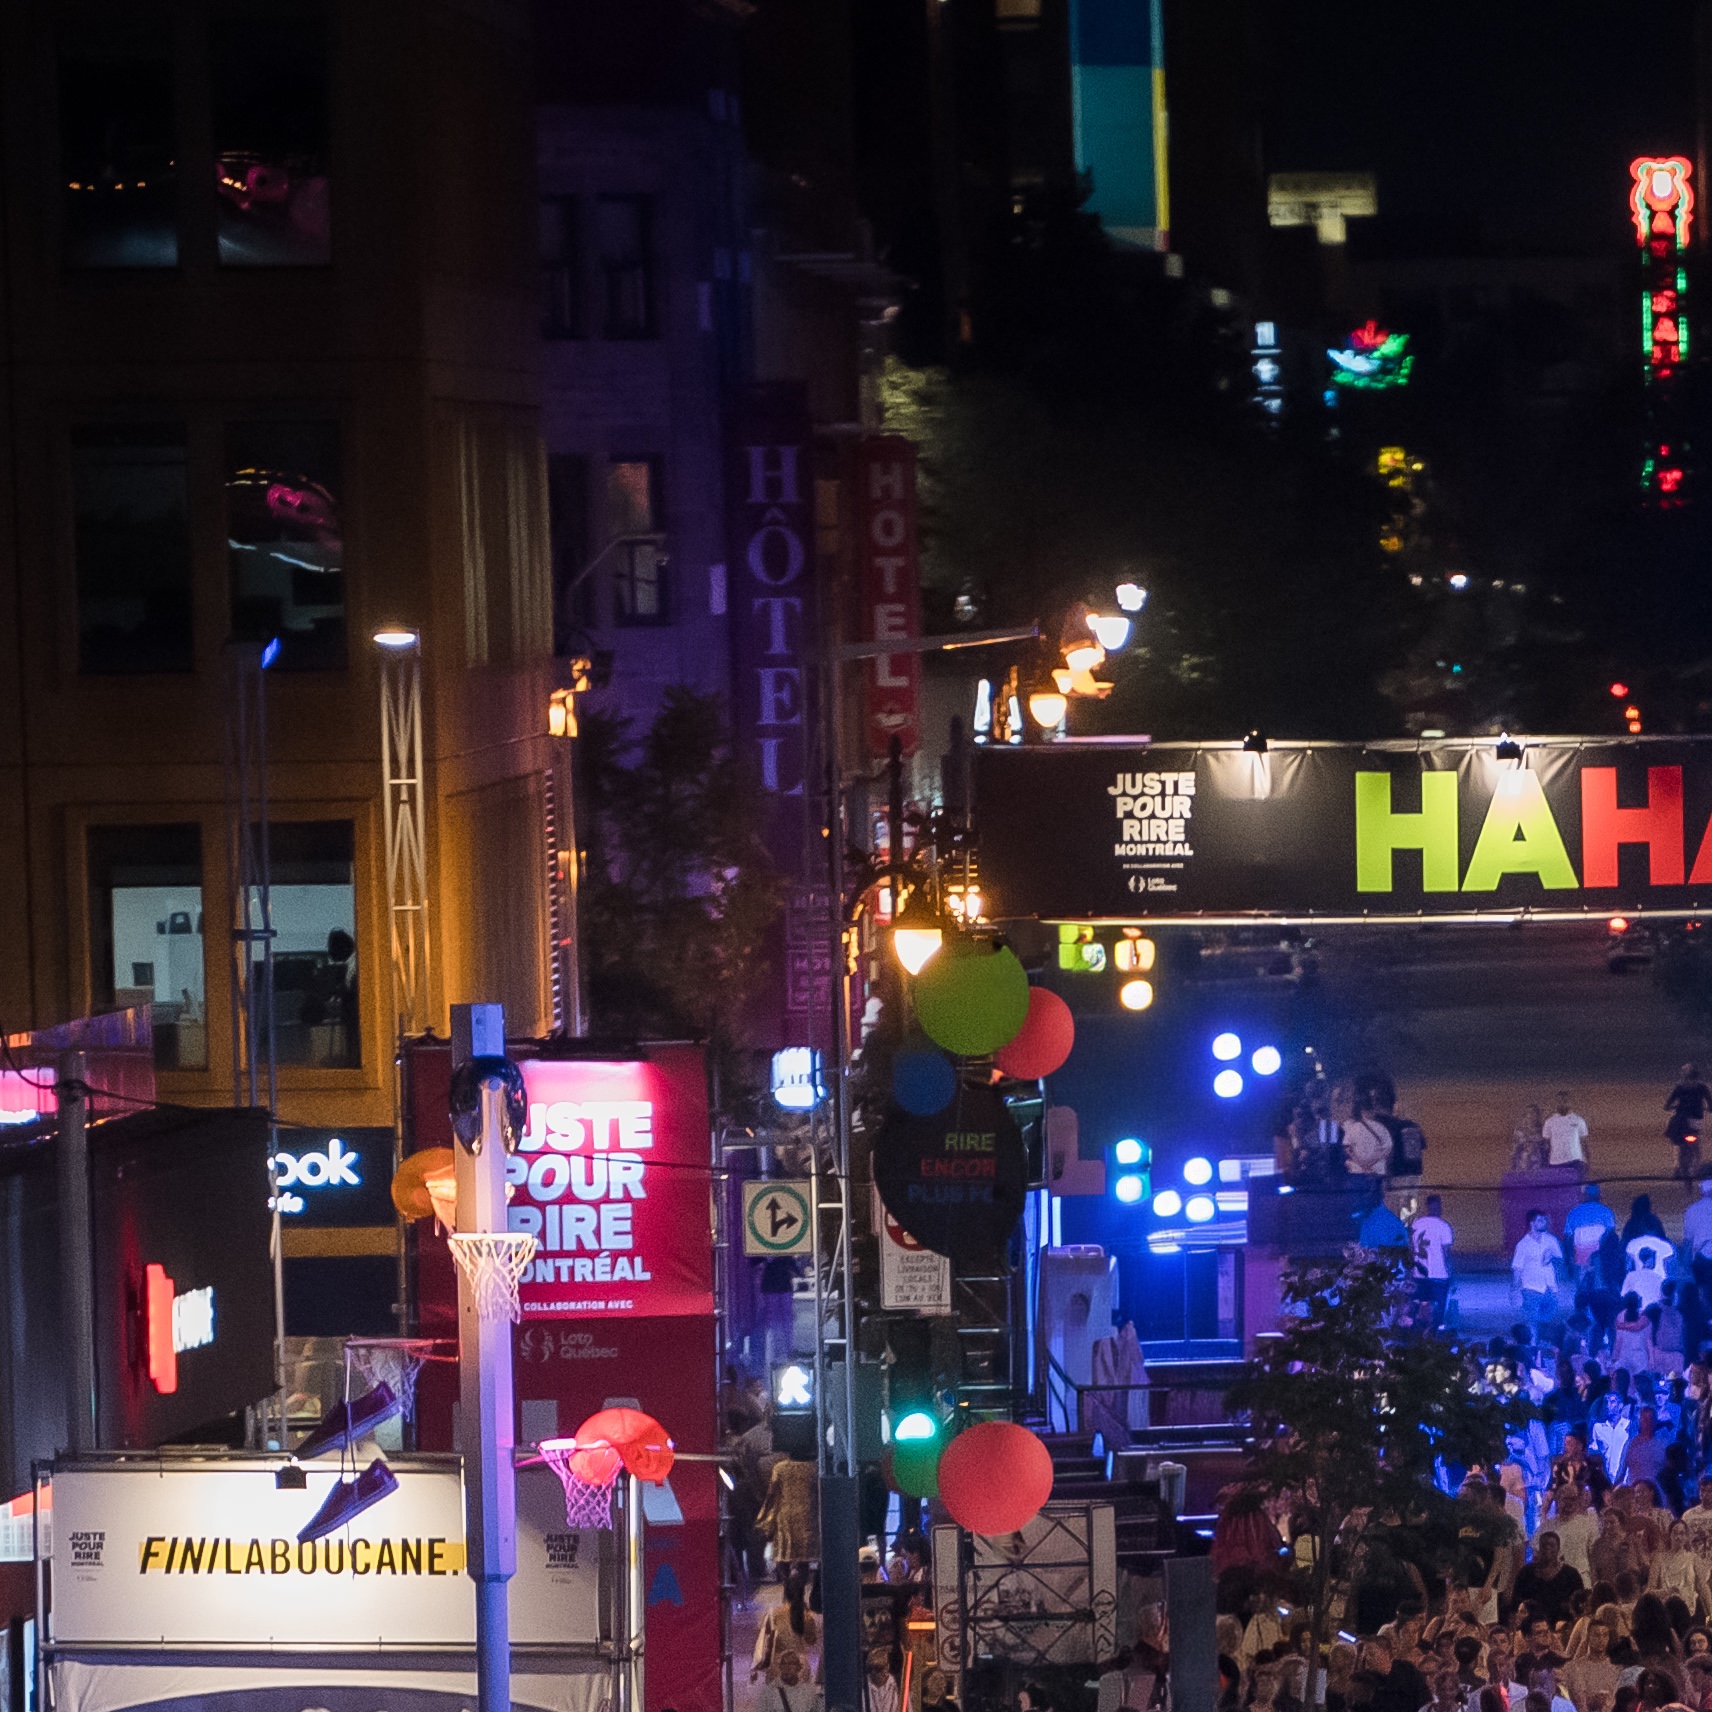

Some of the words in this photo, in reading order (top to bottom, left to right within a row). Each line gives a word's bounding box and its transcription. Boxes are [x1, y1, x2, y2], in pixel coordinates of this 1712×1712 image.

[869, 462, 909, 689] HOTEL
[748, 446, 804, 796] HÔTEL
[1106, 771, 1196, 796] JUSTE
[1115, 795, 1192, 819] POUR
[1122, 818, 1186, 842] RIRE
[1114, 841, 1194, 857] MONTRÉAL
[507, 1202, 633, 1252] RIRE
[518, 1251, 652, 1284] ONTRÉAL
